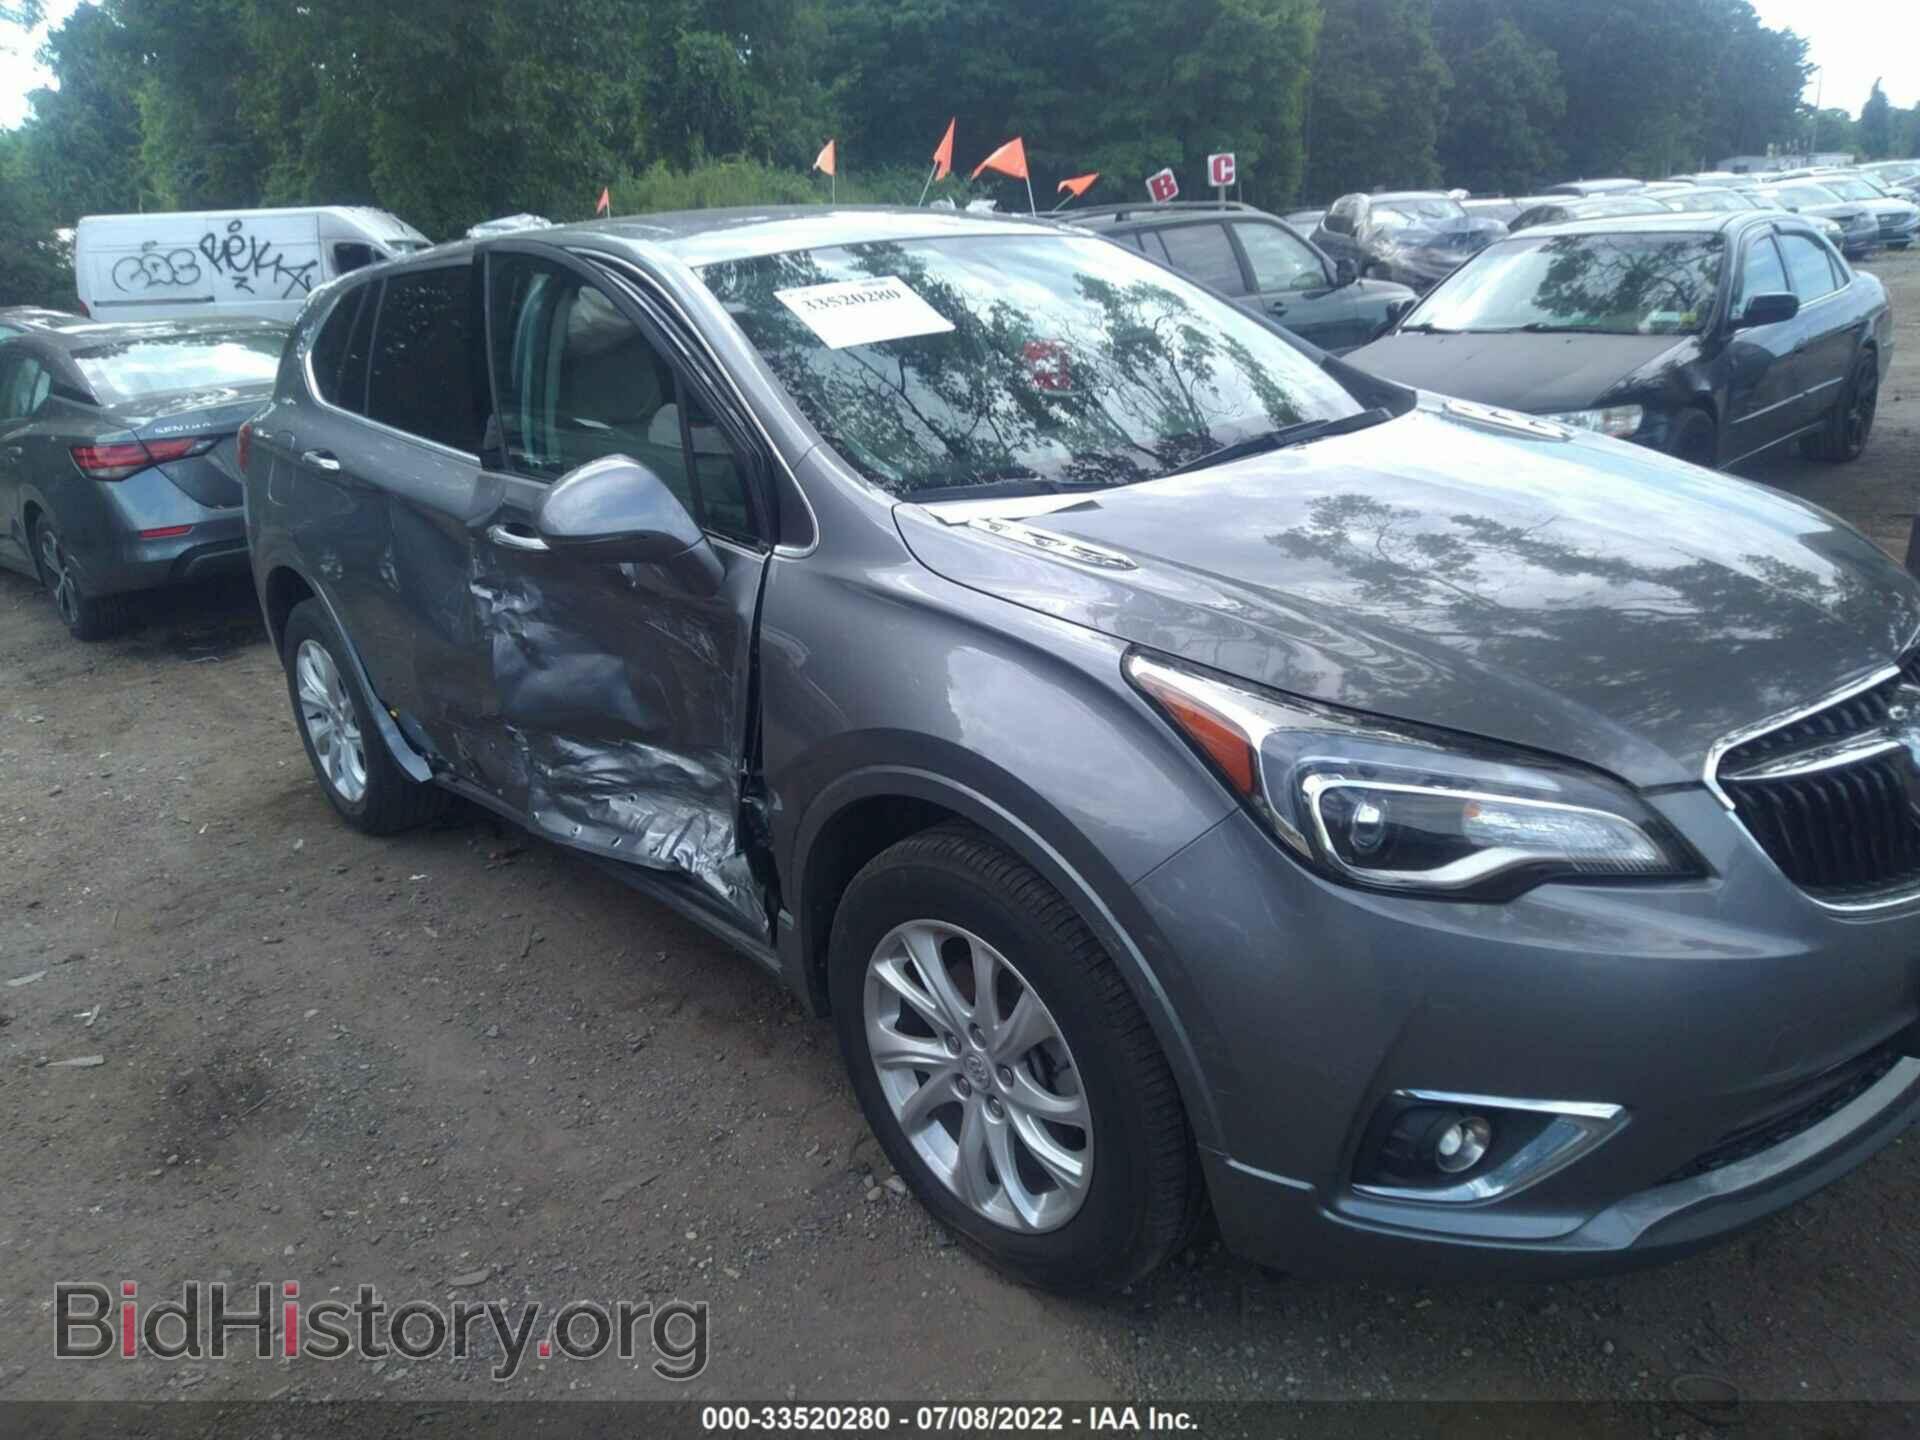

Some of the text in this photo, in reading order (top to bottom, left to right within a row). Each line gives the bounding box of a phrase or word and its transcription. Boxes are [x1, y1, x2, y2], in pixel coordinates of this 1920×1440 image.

[1212, 155, 1234, 183] C
[1150, 174, 1177, 202] B
[801, 288, 901, 313] 33520280
